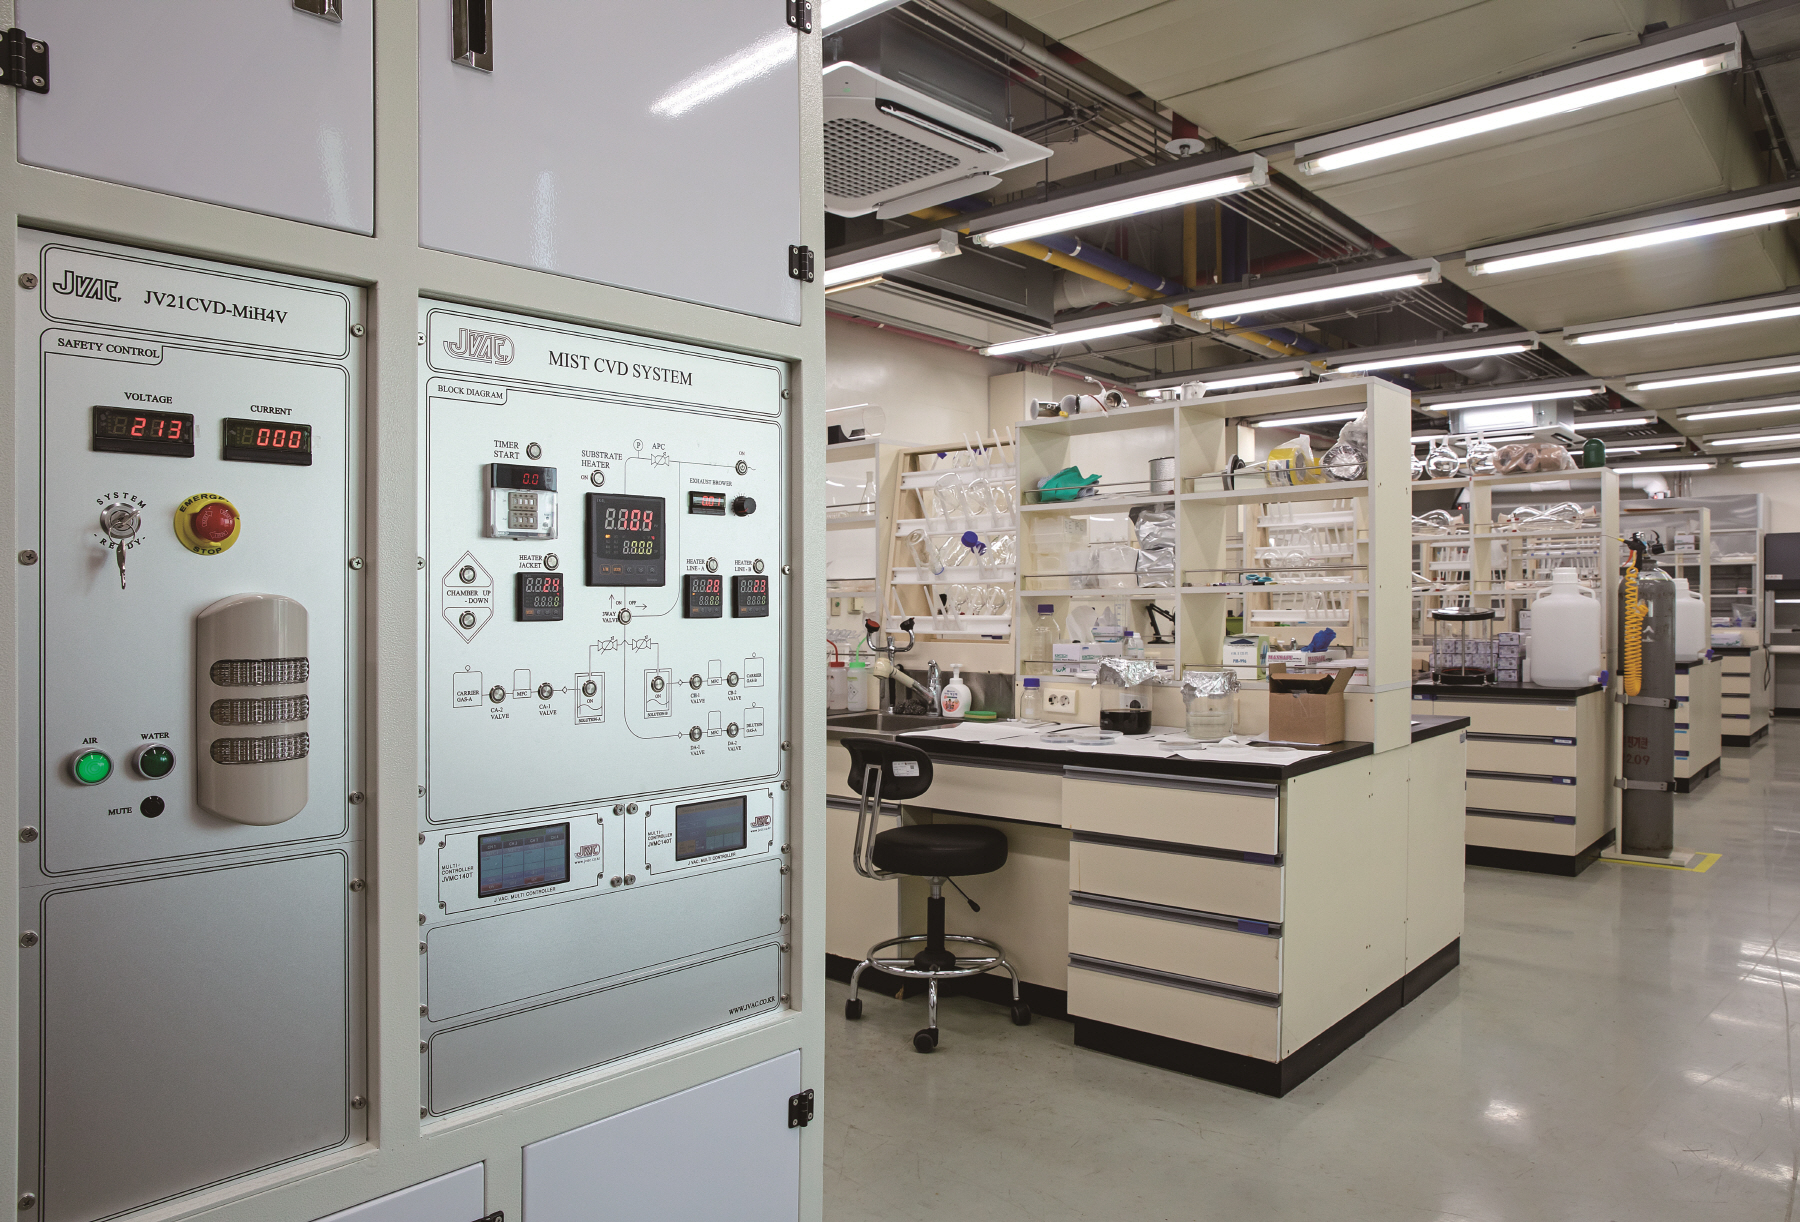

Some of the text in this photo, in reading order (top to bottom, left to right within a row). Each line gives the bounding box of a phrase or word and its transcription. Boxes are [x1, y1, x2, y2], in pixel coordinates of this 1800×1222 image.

[144, 290, 288, 324] JV21CVD-MiH4V
[57, 337, 160, 359] SAFETY CONTROL
[548, 351, 693, 386] MIST CVD SYSTEM
[438, 384, 503, 400] BLOCK DIAGRAM
[124, 392, 173, 404] VOLTAGE
[250, 405, 292, 416] CURRENT
[131, 417, 182, 439] 213
[256, 428, 302, 448] 000
[494, 440, 519, 450] TIMER
[652, 442, 666, 450] APC
[493, 451, 520, 460] START
[581, 450, 623, 461] SUBSTRATE
[581, 460, 610, 469] HEATER
[96, 491, 147, 509] SYSTEM
[99, 538, 142, 550] REDY
[193, 546, 222, 555] STOP
[82, 737, 98, 745] AIR
[140, 732, 170, 740] WATER
[108, 806, 133, 816] MUTE
[442, 866, 473, 875] CONTROLLER
[442, 872, 473, 882] JVMC140T
[526, 887, 556, 896] CONTROLLER
